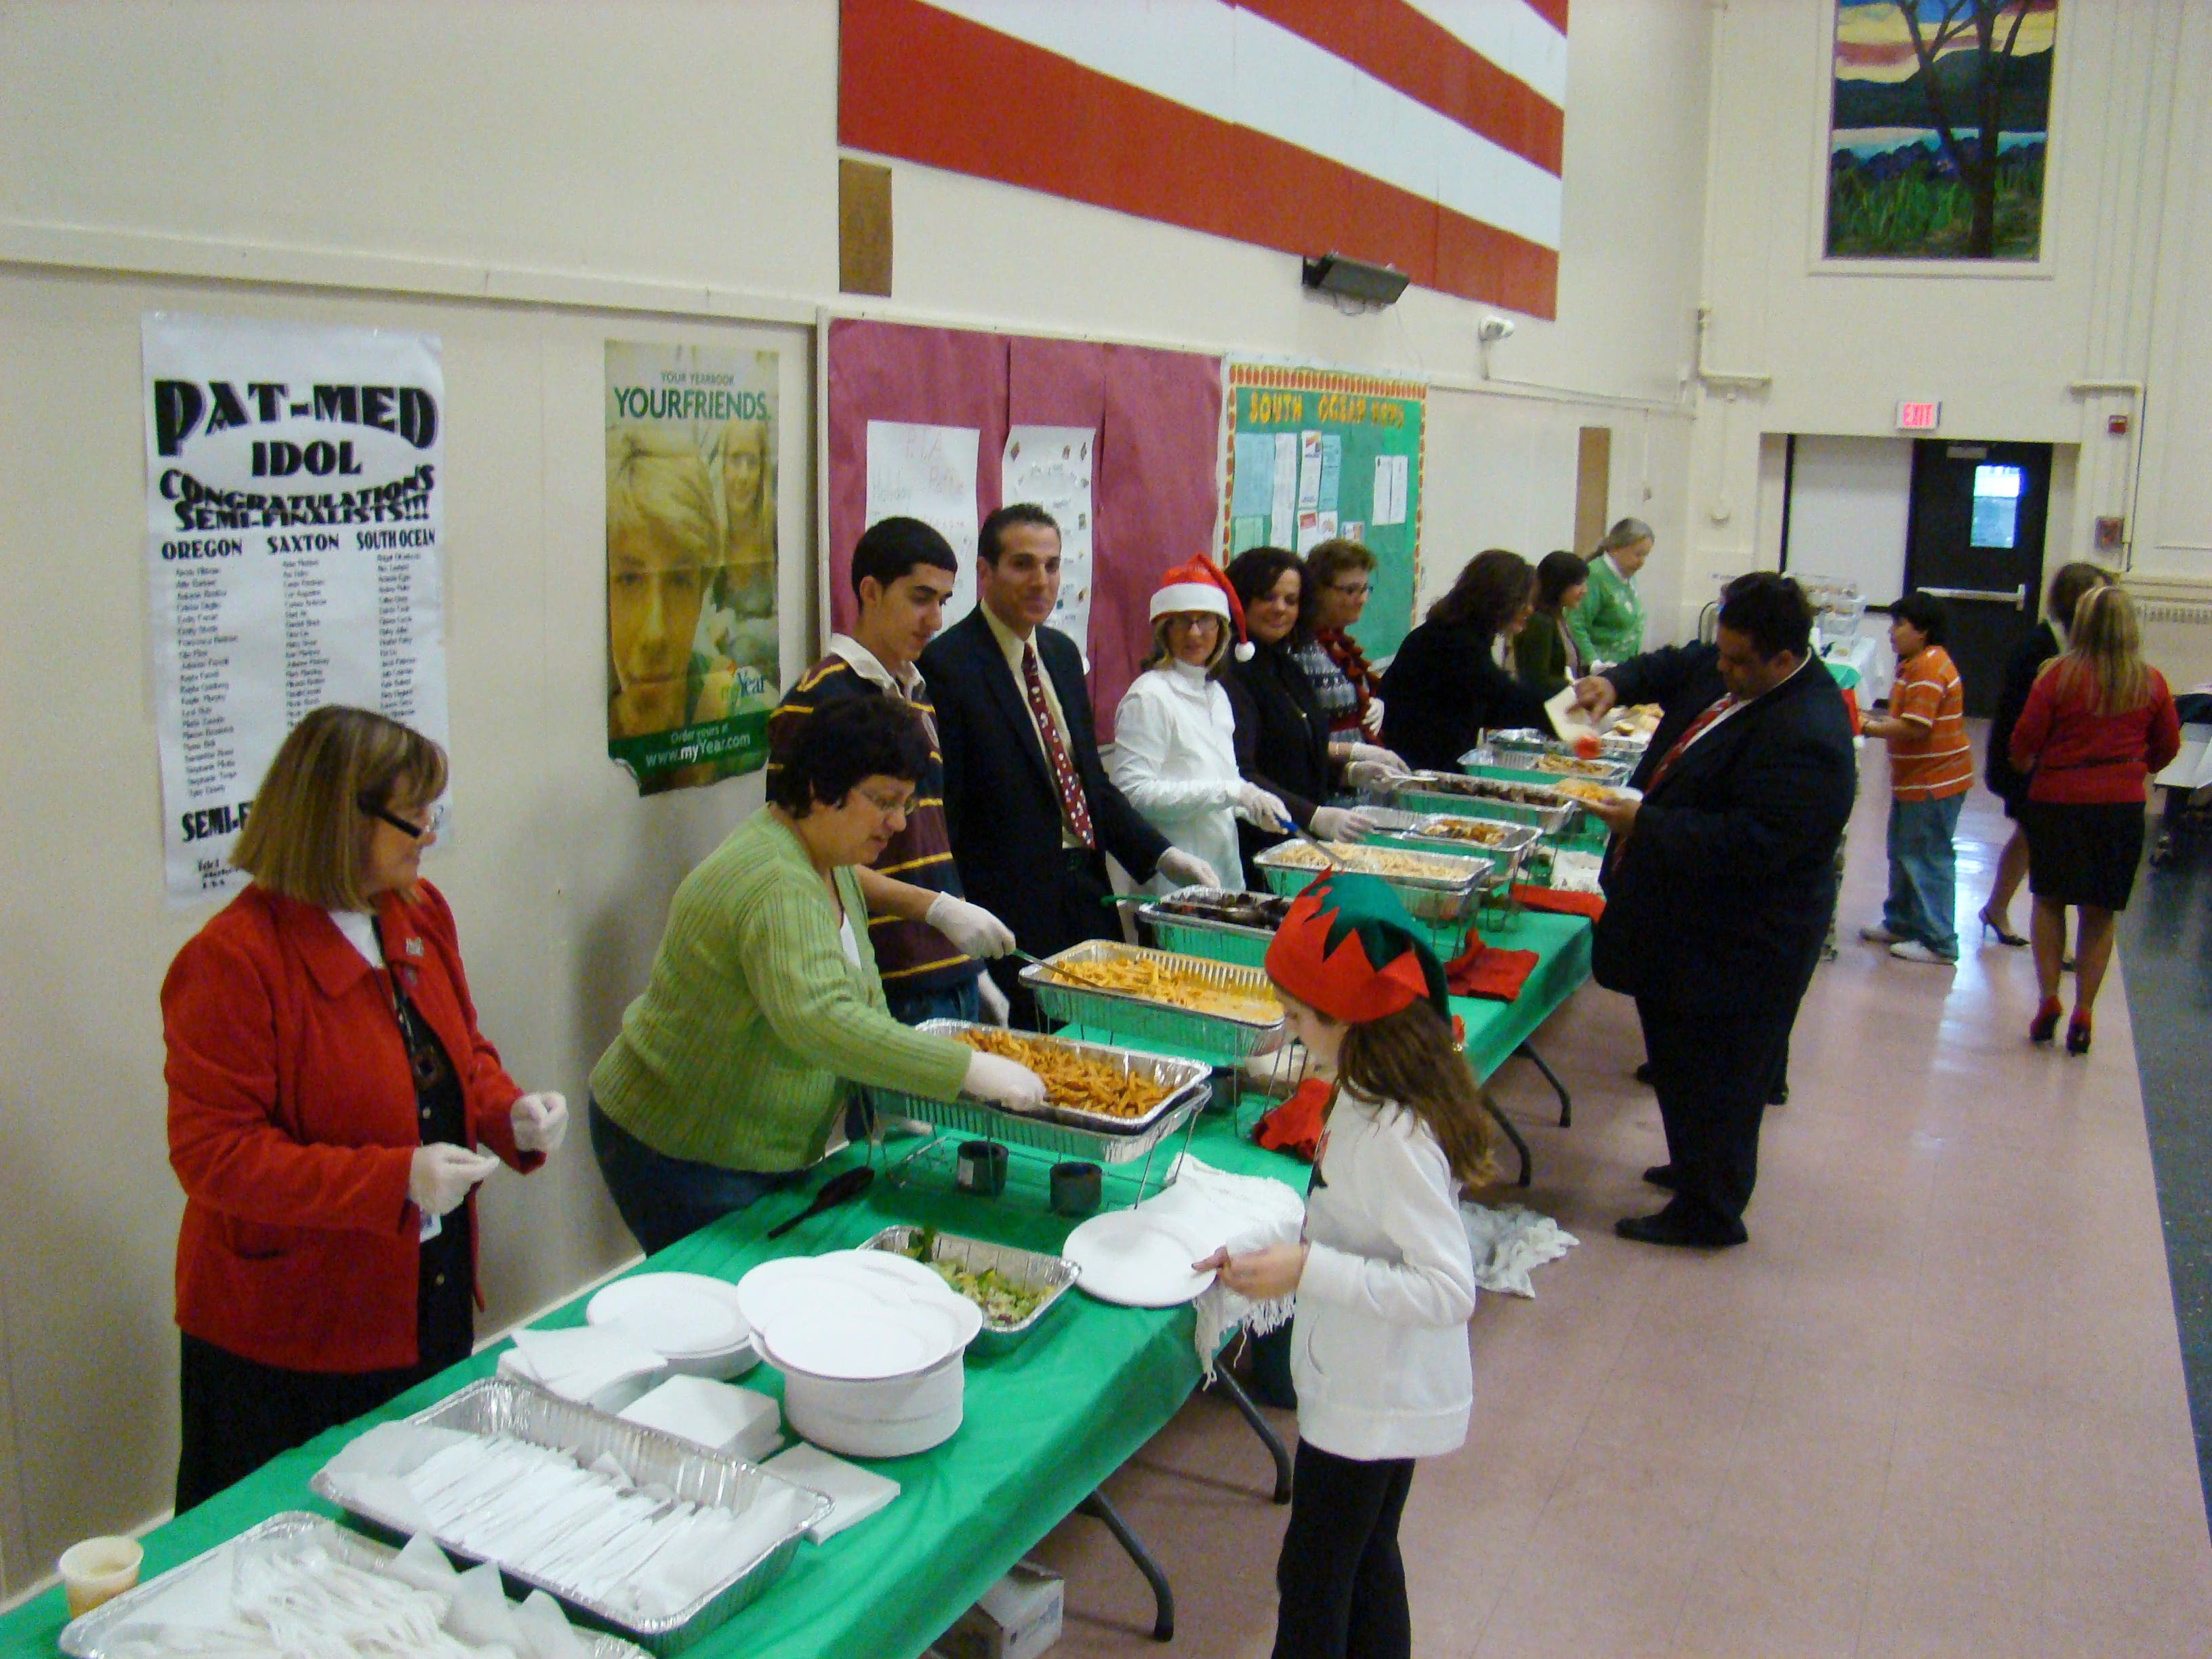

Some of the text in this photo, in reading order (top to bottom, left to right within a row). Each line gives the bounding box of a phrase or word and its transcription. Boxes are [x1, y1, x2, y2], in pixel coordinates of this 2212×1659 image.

[155, 380, 439, 457] PAT-MED
[1249, 391, 1302, 424] SOUTH
[1902, 403, 1933, 426] EXIT
[251, 441, 363, 477] IDOL
[161, 539, 243, 560] OREGON
[266, 533, 340, 556] SAXTON
[356, 527, 436, 551] SOUTH OCEAN
